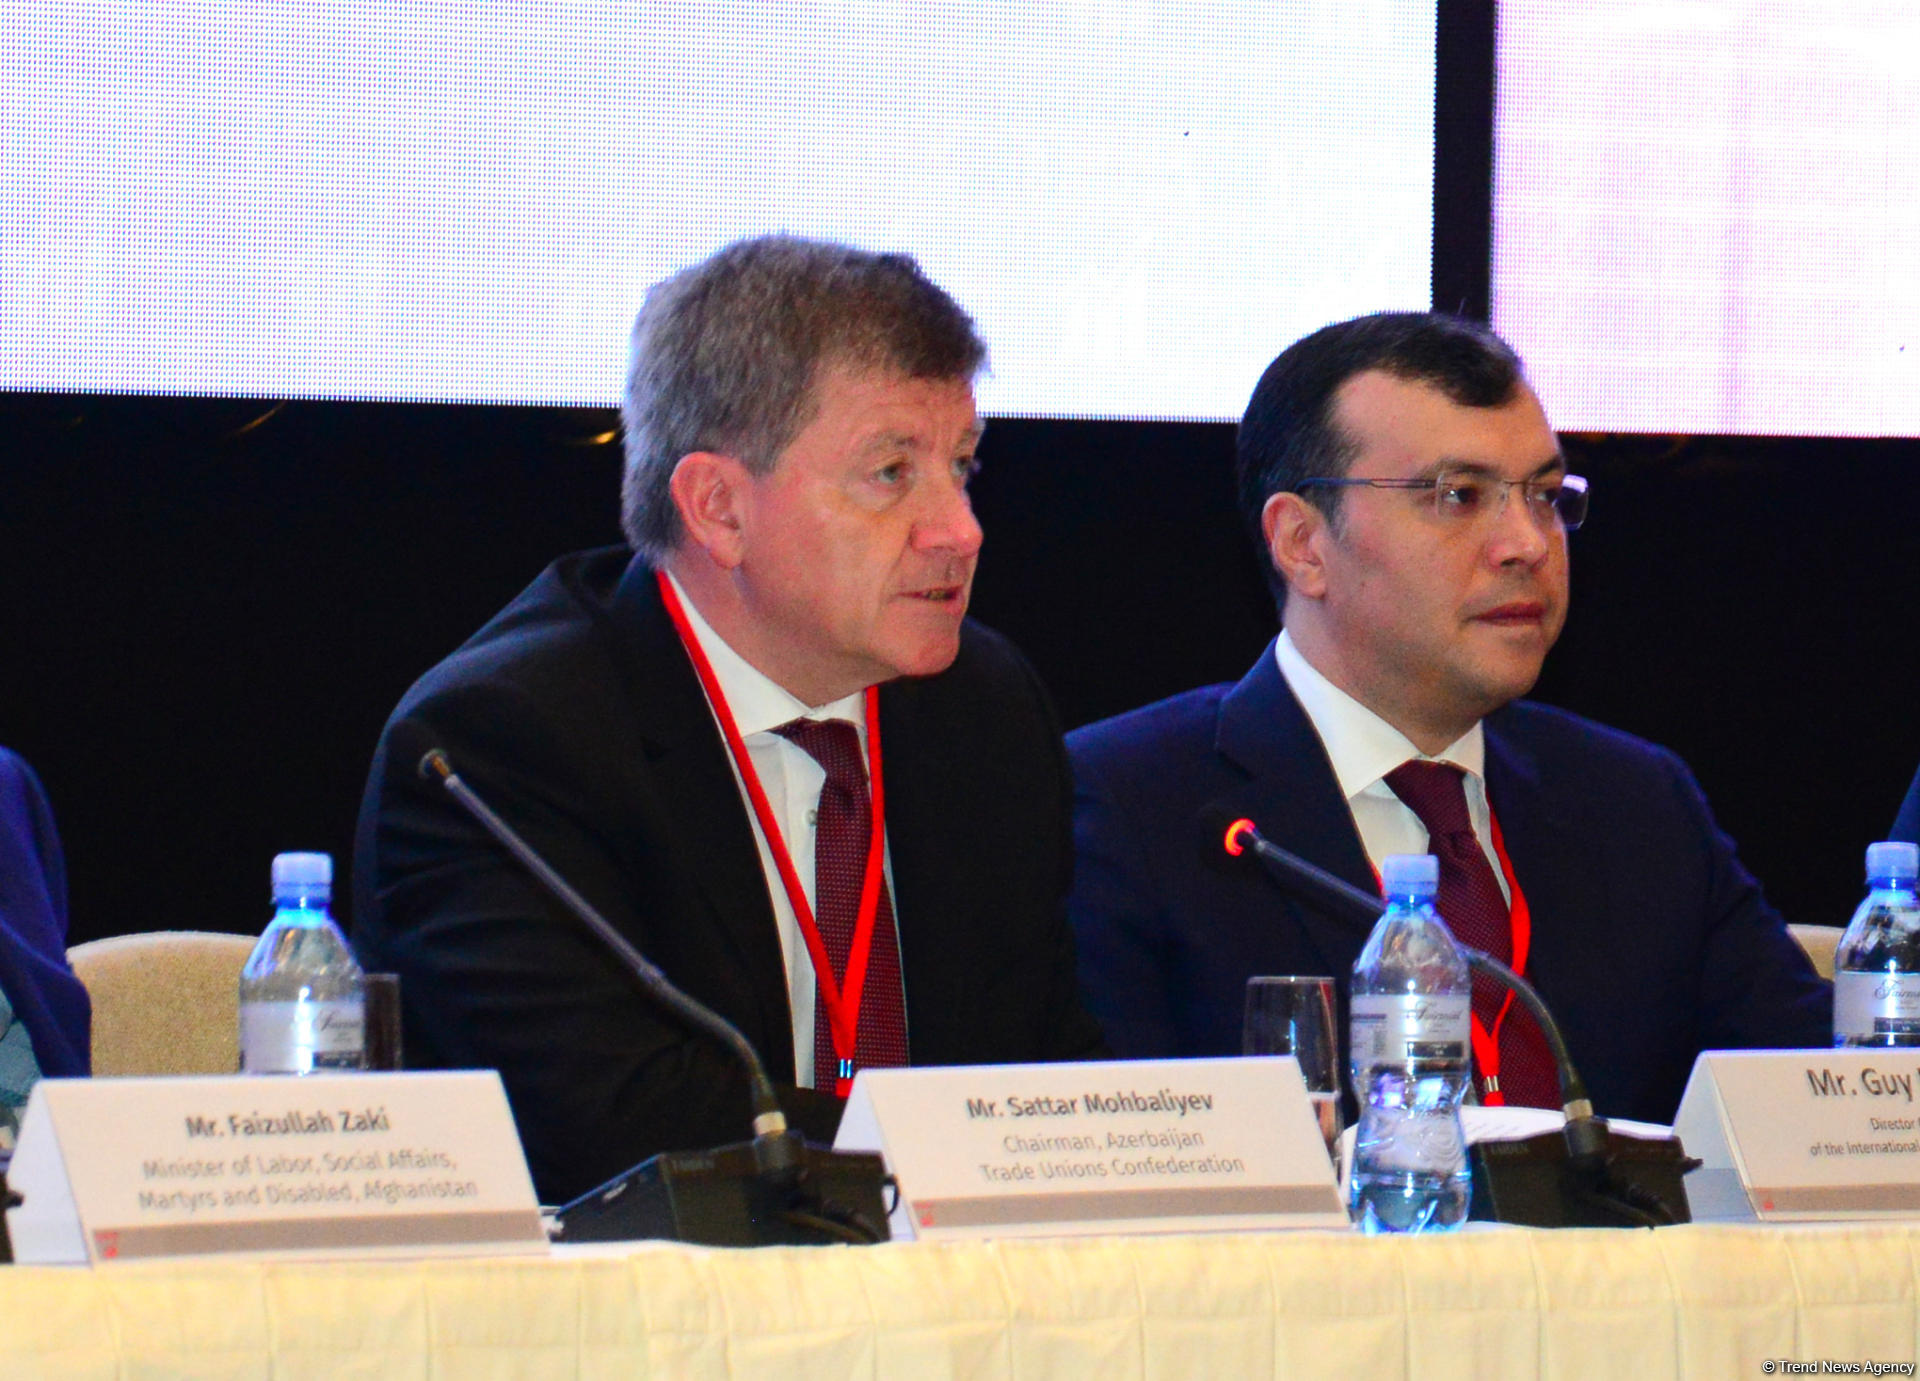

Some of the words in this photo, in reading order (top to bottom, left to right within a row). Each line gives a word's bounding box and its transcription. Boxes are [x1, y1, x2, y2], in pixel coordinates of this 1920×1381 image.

[1806, 1068, 1857, 1096] Mr.
[1861, 1067, 1913, 1102] Guy
[966, 1098, 1004, 1118] Mr.
[1007, 1097, 1078, 1117] Sattar
[1083, 1088, 1213, 1116] Mohbaliyev
[185, 1115, 225, 1138] Mr.
[228, 1109, 334, 1136] Faizullah
[338, 1106, 390, 1132] Zaki
[1869, 1117, 1915, 1130] Director
[1003, 1132, 1102, 1153] Chairman,
[1107, 1128, 1204, 1150] Azerbaijan
[1810, 1142, 1821, 1156] of
[1824, 1142, 1844, 1155] the
[143, 1157, 225, 1180] Minister
[232, 1155, 251, 1176] of
[257, 1154, 321, 1176] Labor,
[322, 1151, 382, 1173] Social
[388, 1149, 458, 1171] Affairs,
[979, 1162, 1036, 1181] Trade
[1040, 1159, 1109, 1179] Unions
[1112, 1154, 1245, 1176] Confederation
[138, 1189, 217, 1212] Martyrs
[223, 1185, 261, 1207] and
[265, 1181, 361, 1205] Disabled,
[364, 1178, 479, 1205] Afghanistan
